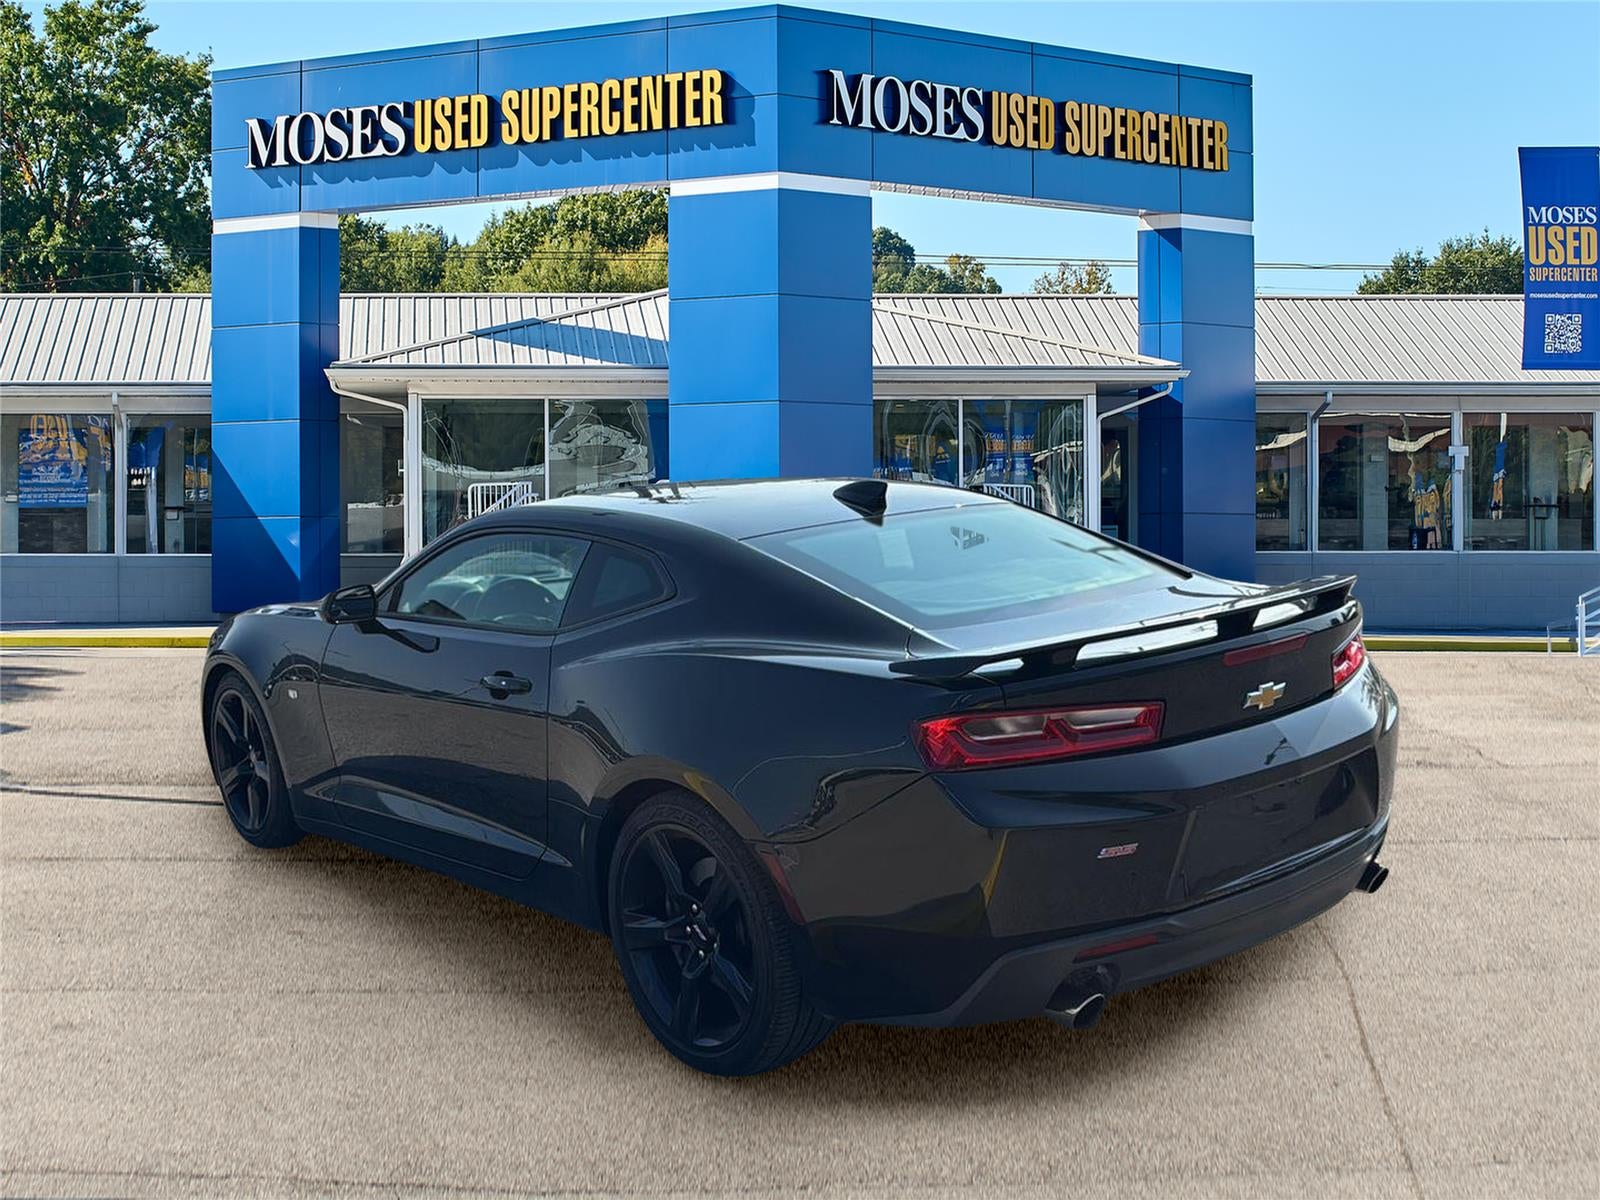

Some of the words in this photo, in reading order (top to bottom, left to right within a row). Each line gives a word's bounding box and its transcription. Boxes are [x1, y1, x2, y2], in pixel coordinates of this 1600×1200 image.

[245, 101, 407, 170] MOSES
[413, 93, 489, 153] USED
[501, 69, 723, 146] SUPERCENTER
[829, 69, 984, 142] MOSES
[991, 91, 1055, 150] USED
[1064, 101, 1229, 171] SUPERCENTER
[1528, 206, 1597, 224] MOSES
[1528, 226, 1598, 265] USED
[1529, 267, 1598, 282] SUPERCENTER
